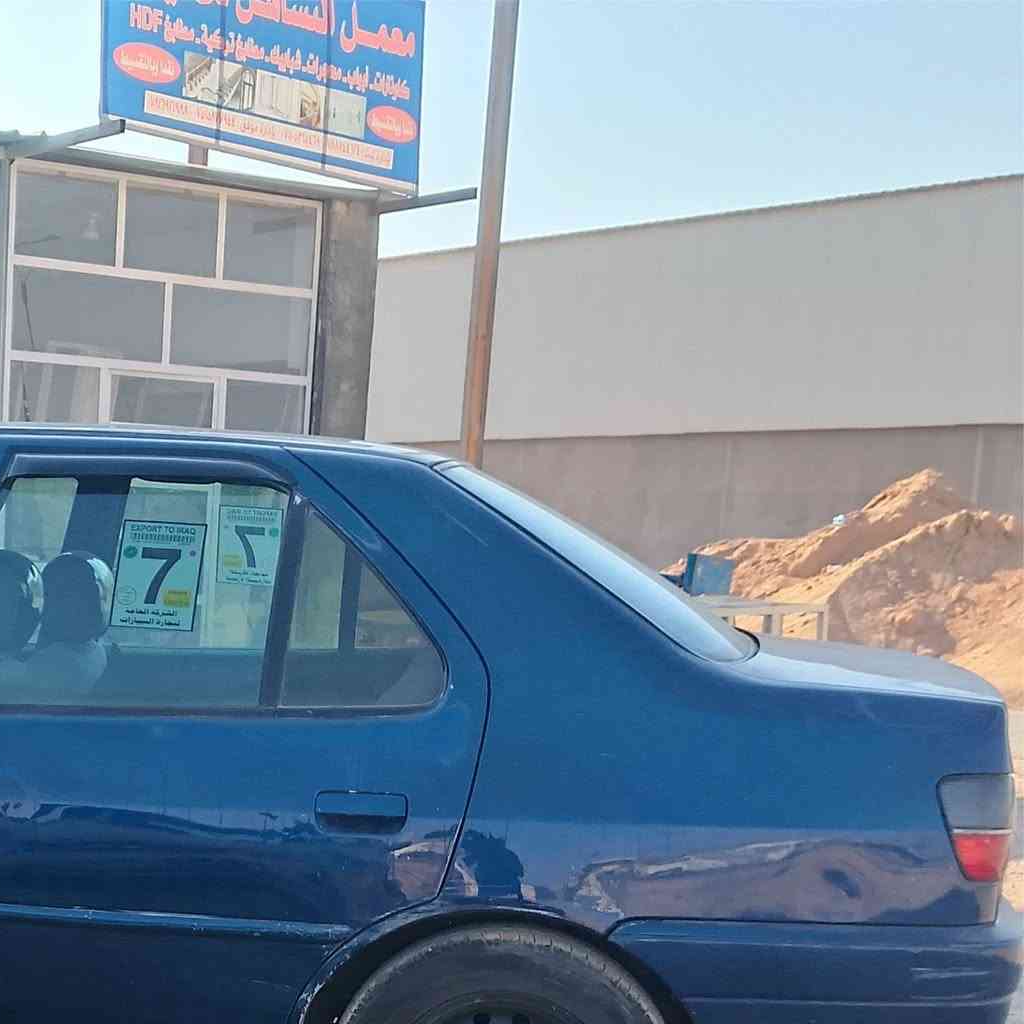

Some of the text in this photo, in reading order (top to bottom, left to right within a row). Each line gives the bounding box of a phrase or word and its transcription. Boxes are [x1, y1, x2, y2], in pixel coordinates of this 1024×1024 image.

[129, 3, 164, 33] HDF
[339, 1, 416, 58] معمل
[164, 526, 175, 534] TO
[141, 547, 182, 604] 7
